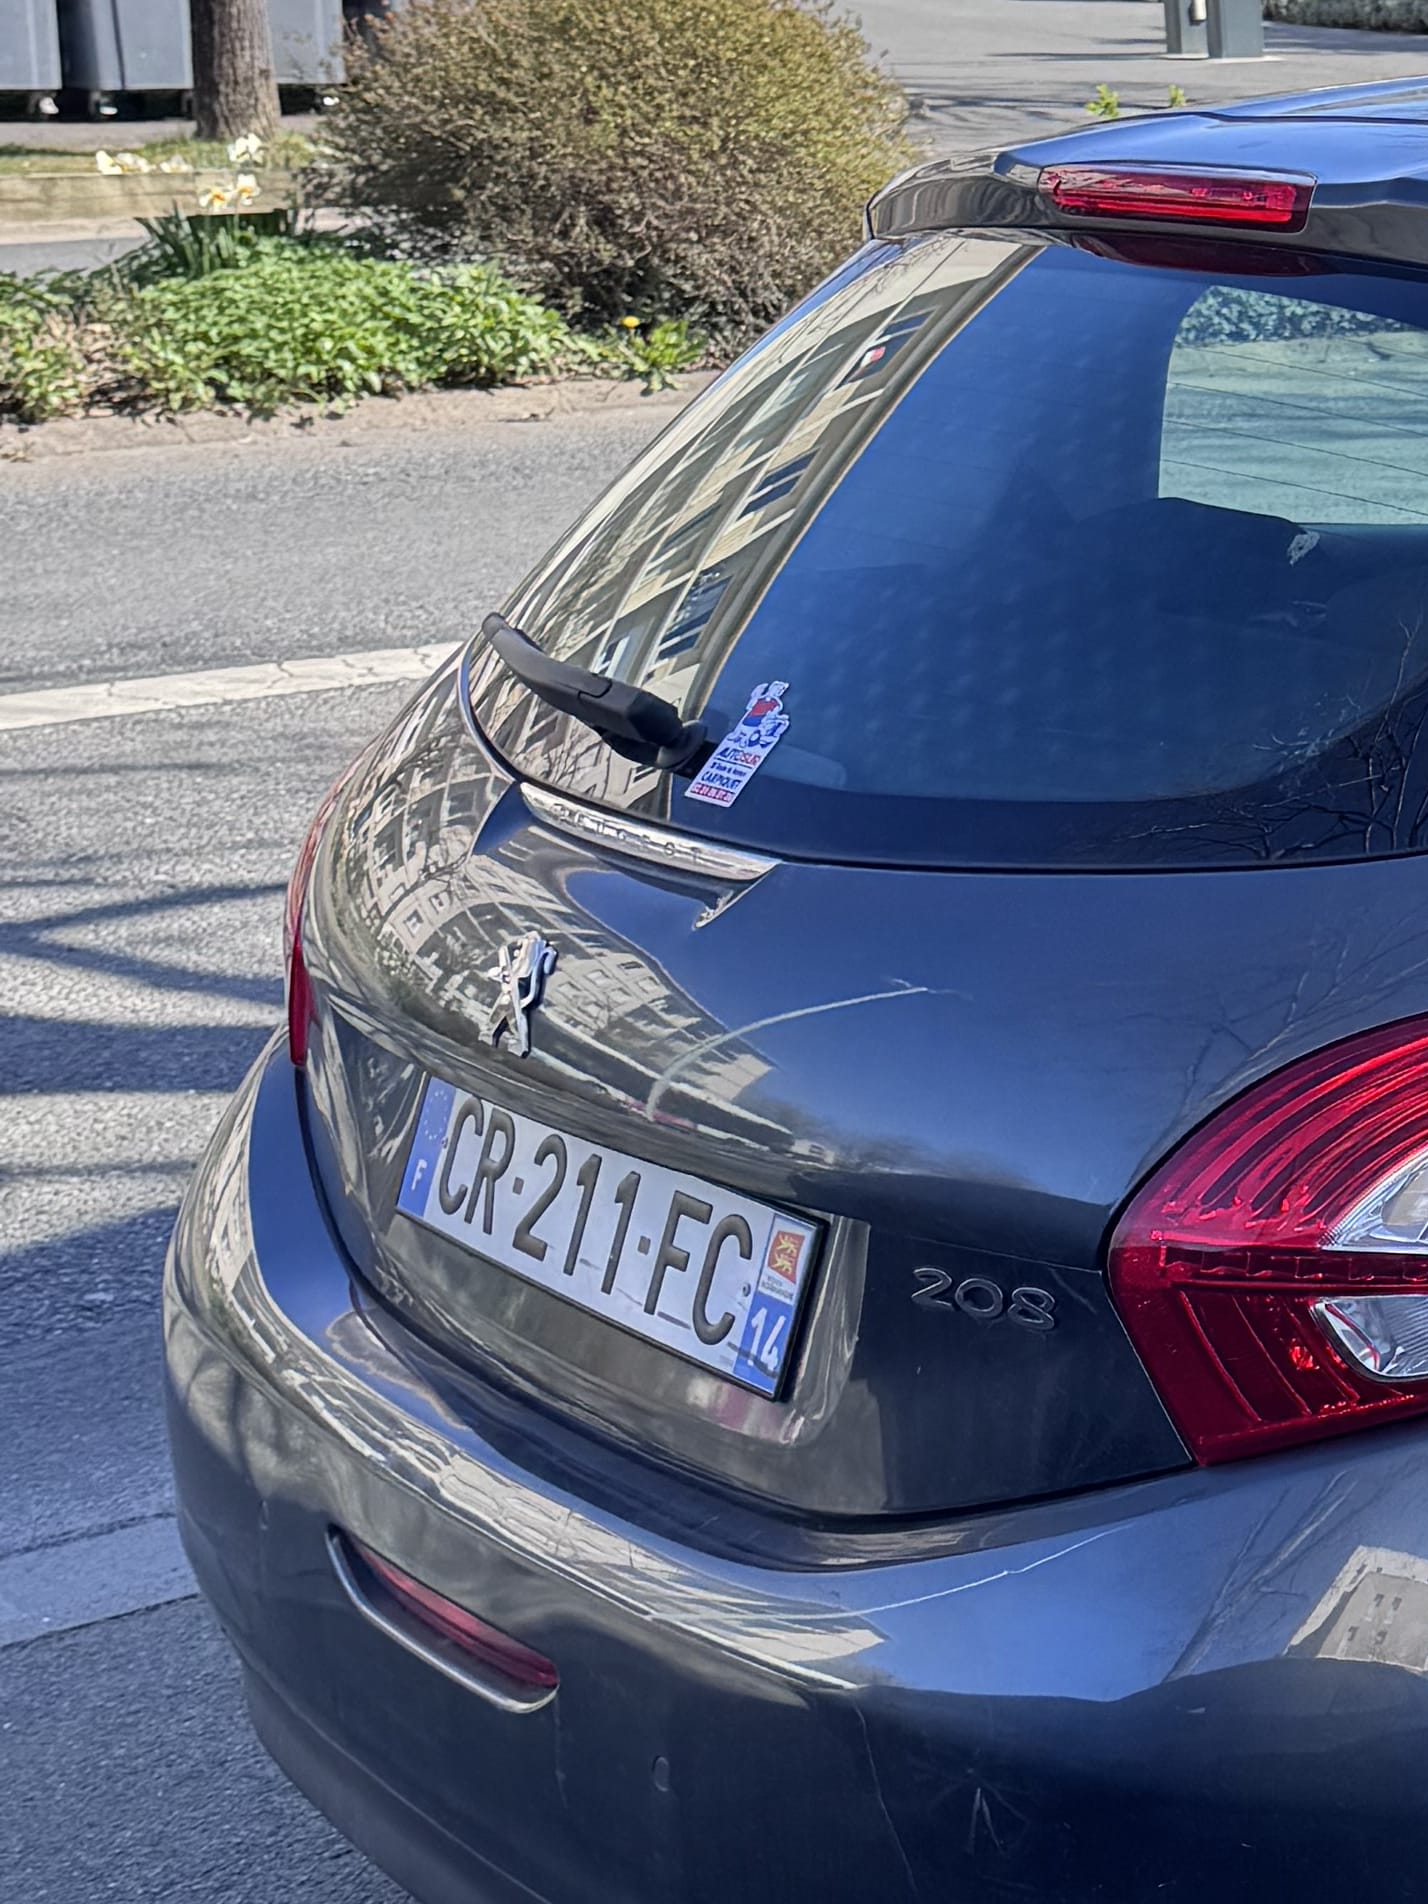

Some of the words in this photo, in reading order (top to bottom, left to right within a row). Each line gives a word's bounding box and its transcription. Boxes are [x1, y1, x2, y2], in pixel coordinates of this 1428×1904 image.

[411, 1158, 428, 1191] F
[439, 1096, 753, 1346] CR-211-FC
[911, 1267, 1056, 1330] 208
[747, 1307, 788, 1372] 14
